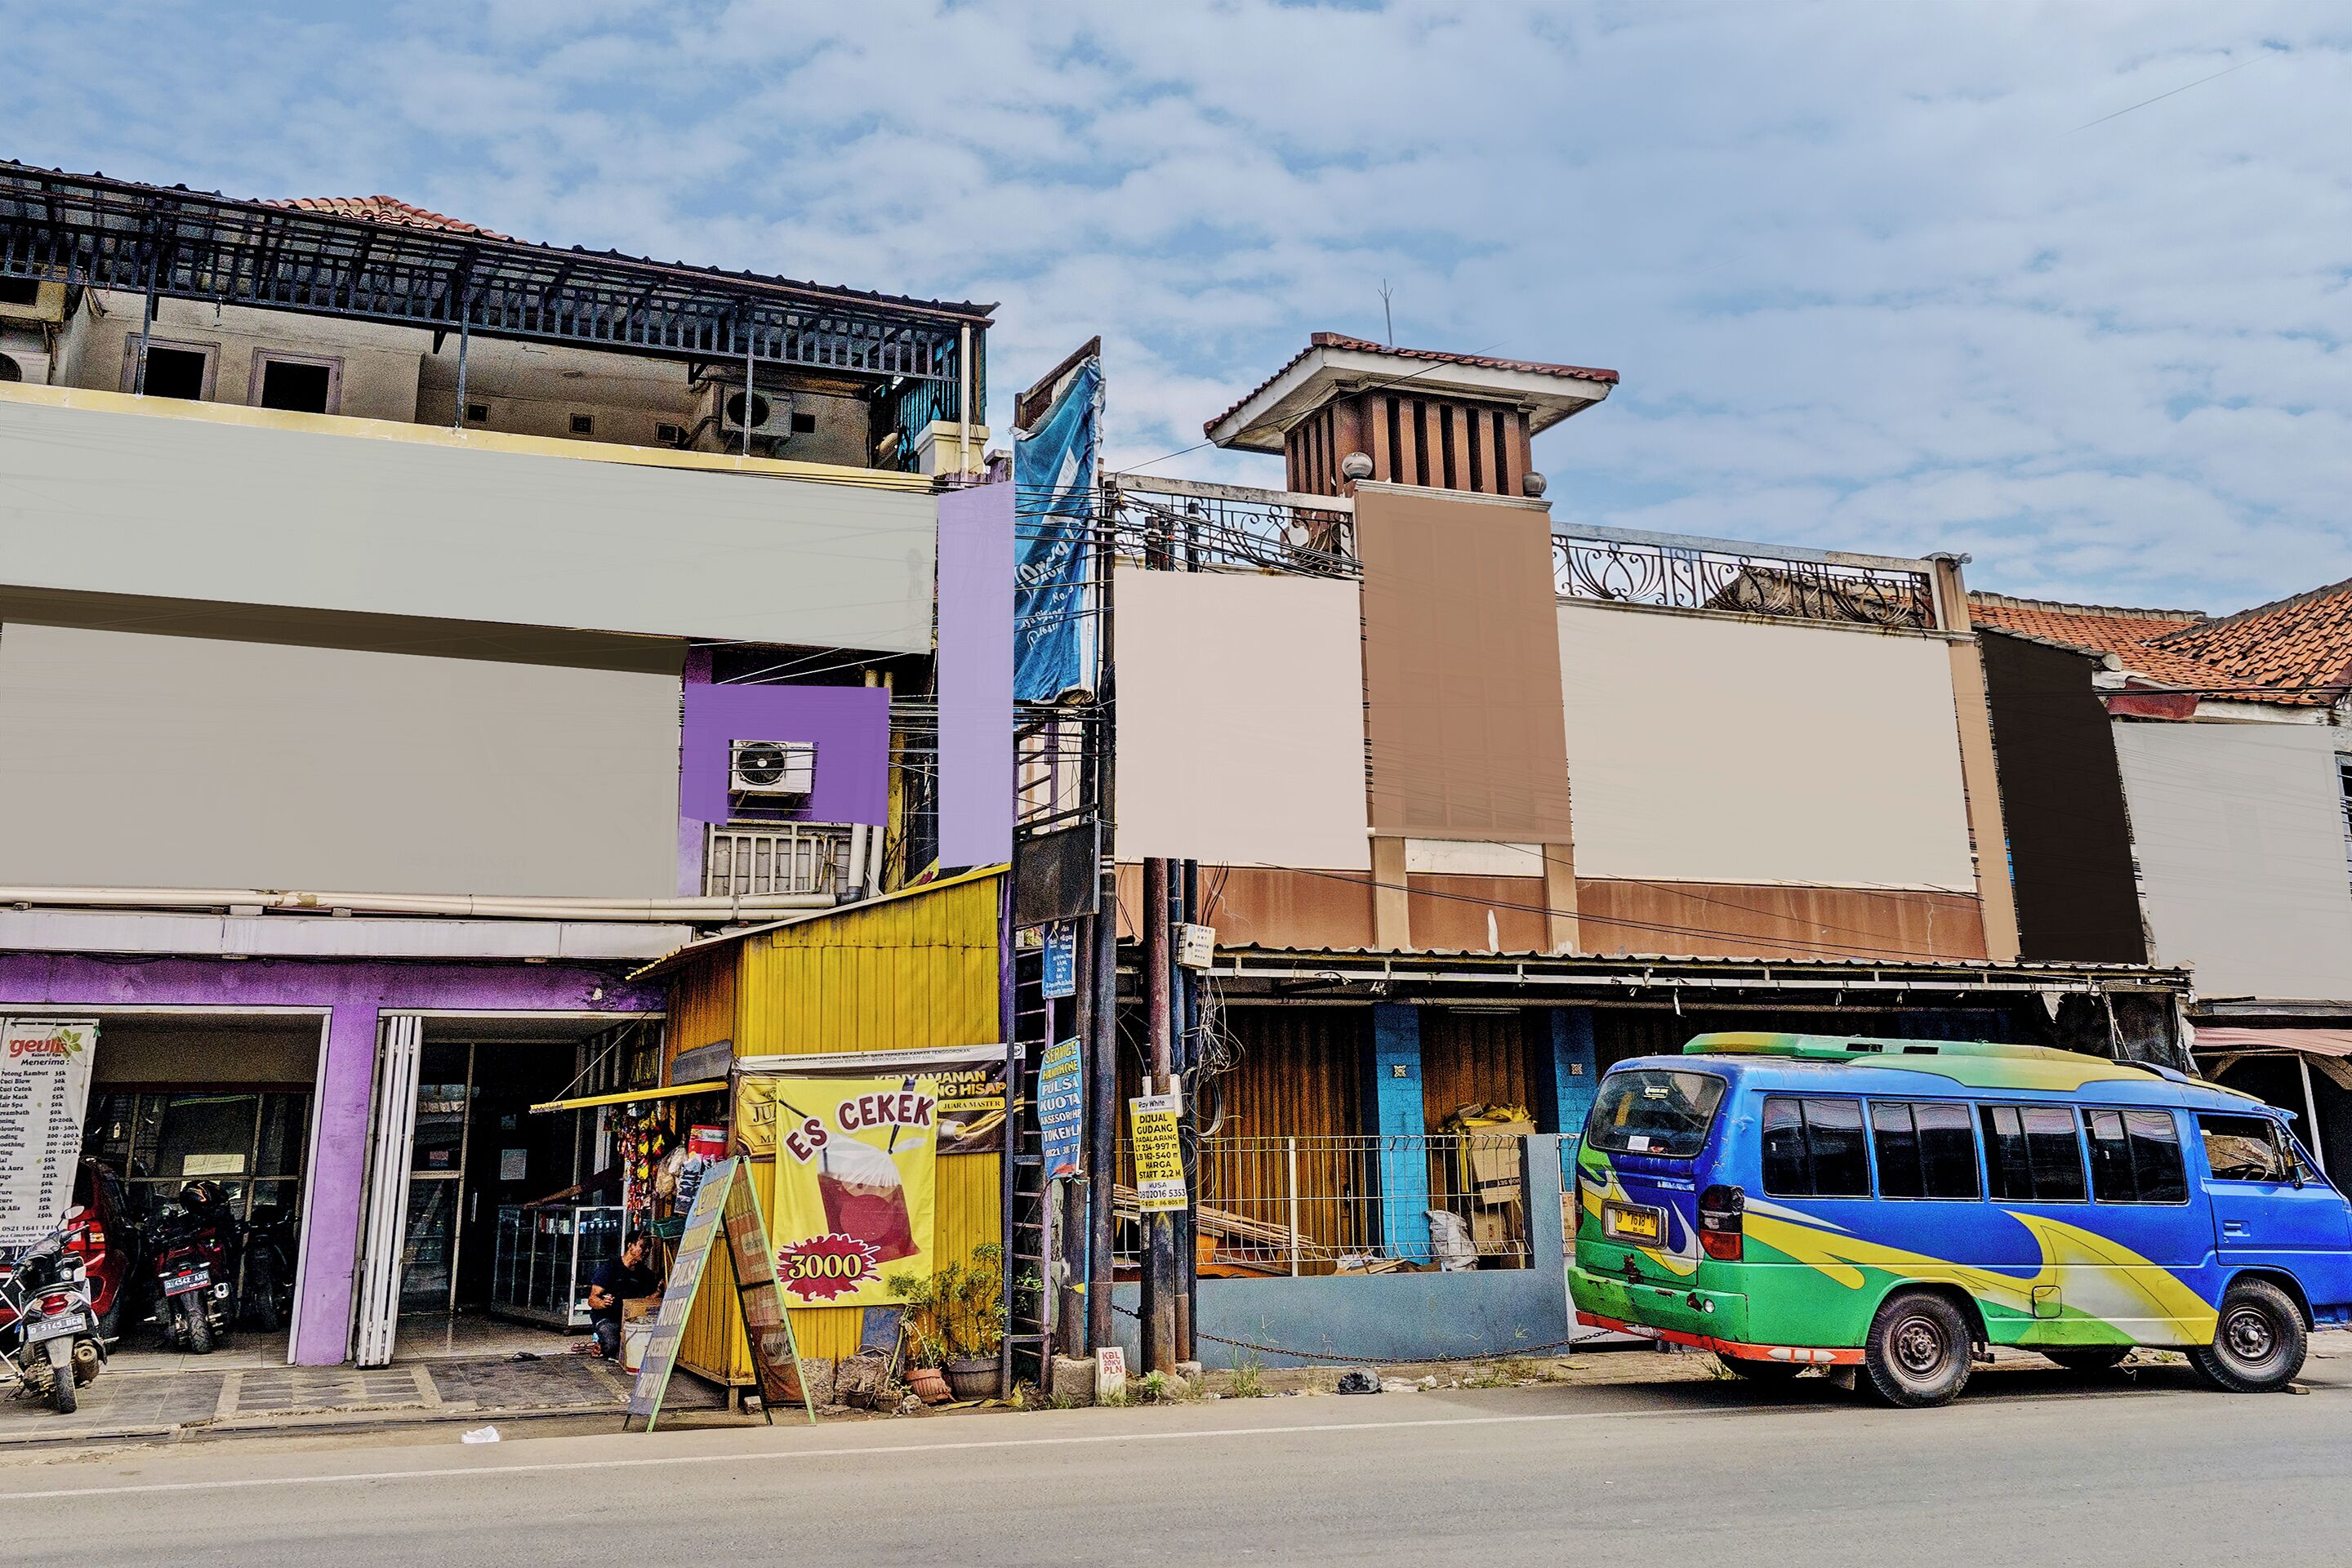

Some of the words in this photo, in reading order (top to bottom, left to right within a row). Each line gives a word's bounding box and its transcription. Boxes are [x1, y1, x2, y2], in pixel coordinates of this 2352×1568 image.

[1045, 1041, 1077, 1064] SERVICE
[960, 1082, 1008, 1095] HISAP
[1041, 1076, 1079, 1096] PULSA
[1040, 1093, 1080, 1112] KUOTA
[1138, 1101, 1148, 1110] Ray
[1139, 1113, 1168, 1124] DIJUAL
[786, 1119, 828, 1161] ES
[839, 1094, 935, 1130] CEKEK
[1137, 1124, 1173, 1134] GUDANG
[1135, 1134, 1176, 1143] PADALARANG
[1142, 1143, 1169, 1152] 234-997
[1139, 1170, 1158, 1178] START
[1160, 1169, 1174, 1178] 2,2
[1169, 1188, 1186, 1197] 5353
[1617, 1210, 1623, 1223] D
[788, 1254, 862, 1280] 3000
[40, 1321, 63, 1331] 5145
[1102, 1352, 1120, 1360] KBL
[1103, 1365, 1123, 1374] PLN
